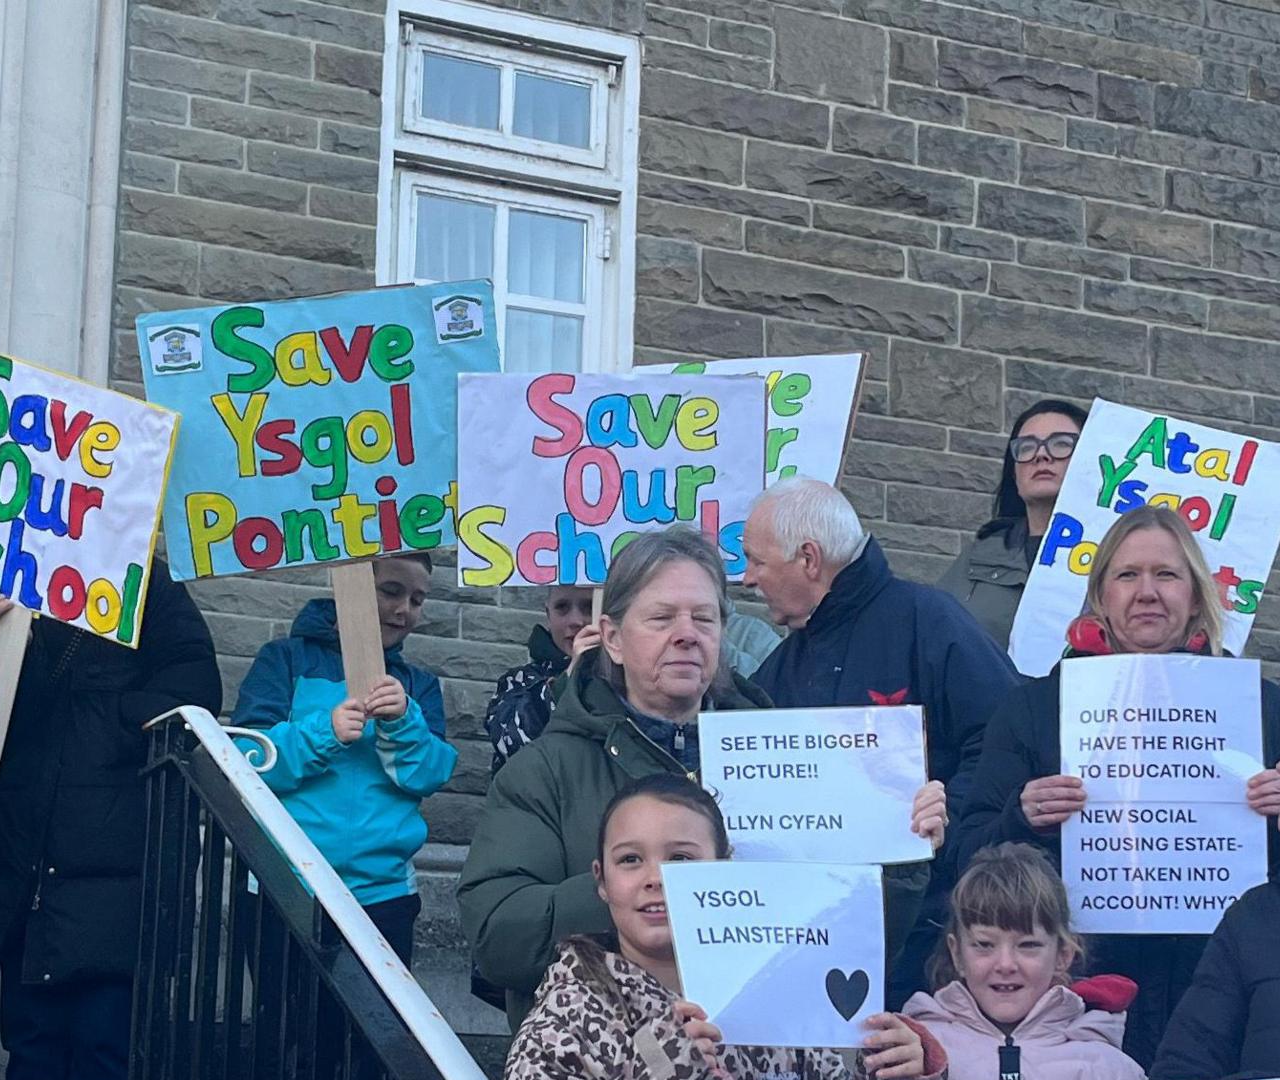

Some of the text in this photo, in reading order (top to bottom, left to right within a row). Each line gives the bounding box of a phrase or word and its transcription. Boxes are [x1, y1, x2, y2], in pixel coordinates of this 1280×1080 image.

[211, 306, 415, 393] Save
[526, 373, 719, 458] Save
[211, 383, 415, 501] Ysgol
[1125, 417, 1258, 486] Atal
[564, 445, 715, 526] Our
[1079, 708, 1217, 724] OUR CHILDREN
[721, 733, 879, 751] SEE THE BIGGER
[1079, 736, 1226, 752] HAVE THE RIGHT
[723, 764, 819, 780] PICTURE!!
[1078, 764, 1221, 779] TO EDUCATION.
[727, 815, 843, 830] LLYN CYFAN
[1080, 809, 1197, 824] NEW SOCIAL
[1080, 837, 1244, 851] HOUSING ESTATE-
[1081, 867, 1230, 882] NOT TAKEN INTO
[693, 890, 765, 908] YSGOL
[1081, 895, 1178, 910] ACCOUNT!
[697, 926, 829, 946] LLANSTEFFAN
